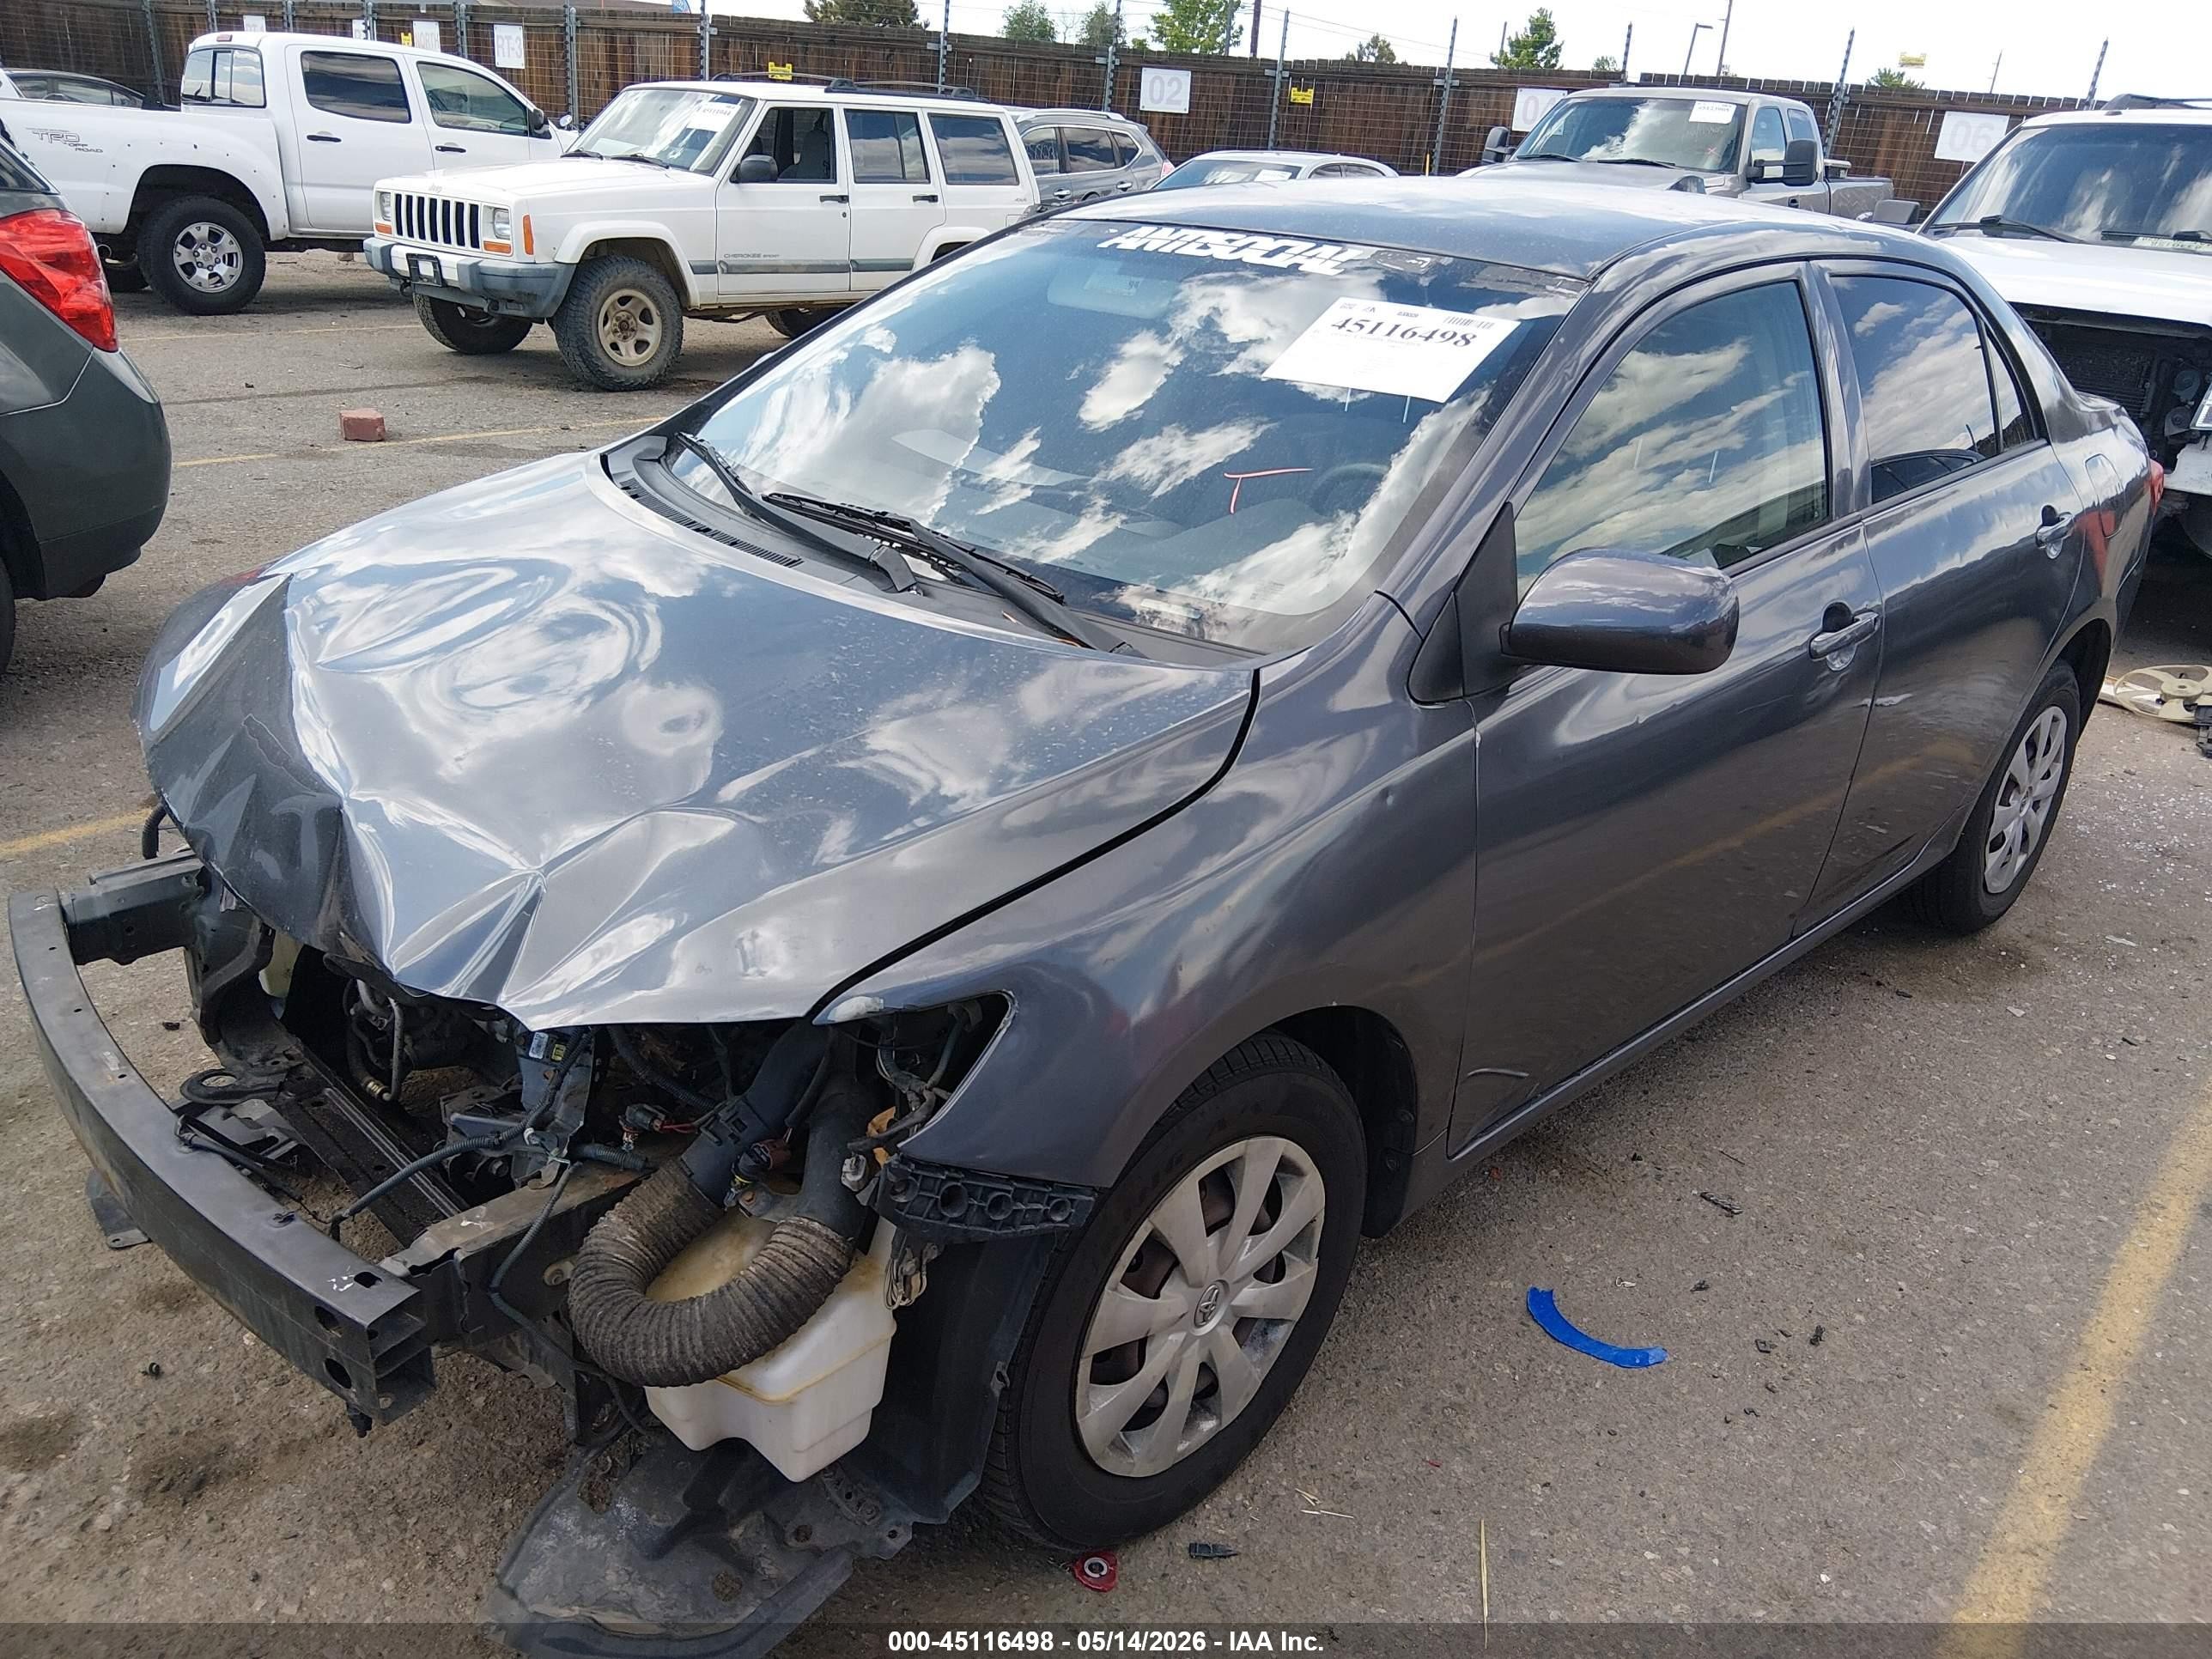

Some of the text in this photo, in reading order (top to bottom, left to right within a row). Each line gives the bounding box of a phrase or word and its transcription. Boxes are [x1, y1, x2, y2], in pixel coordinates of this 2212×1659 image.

[496, 35, 523, 59] RT-3
[1149, 75, 1182, 106] 02
[32, 131, 81, 144] TRD
[1949, 120, 1995, 154] 06
[1330, 316, 1478, 348] 45116498
